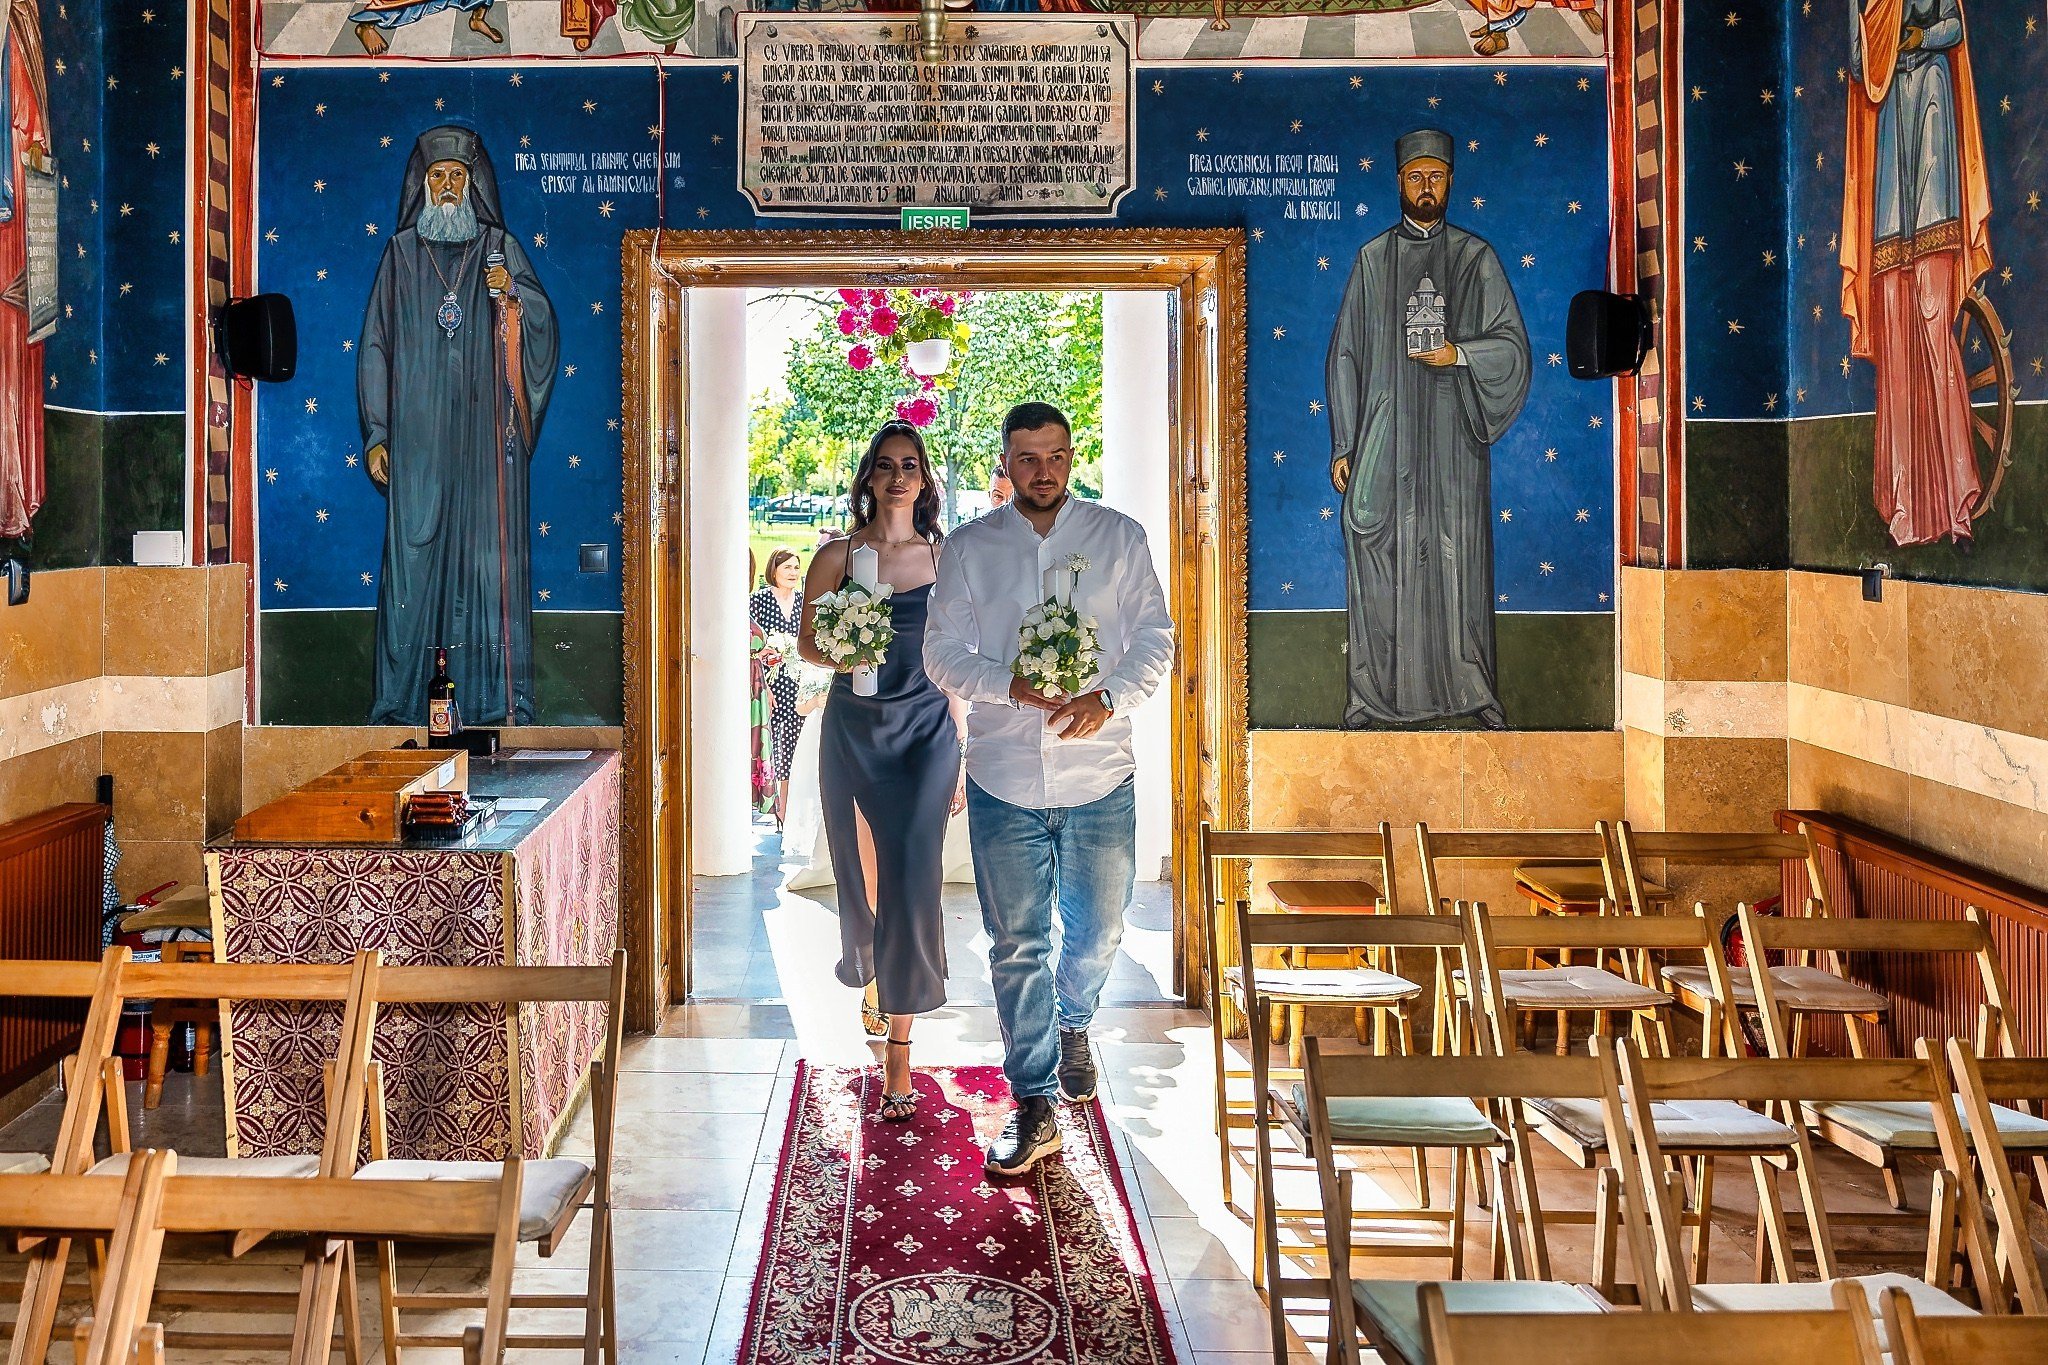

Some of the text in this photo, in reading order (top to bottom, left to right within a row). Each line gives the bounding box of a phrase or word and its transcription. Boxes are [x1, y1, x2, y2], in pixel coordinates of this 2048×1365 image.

[632, 153, 681, 170] GHERSIM
[876, 186, 889, 203] 15
[896, 186, 916, 203] MAI
[908, 216, 962, 230] IESIRE
